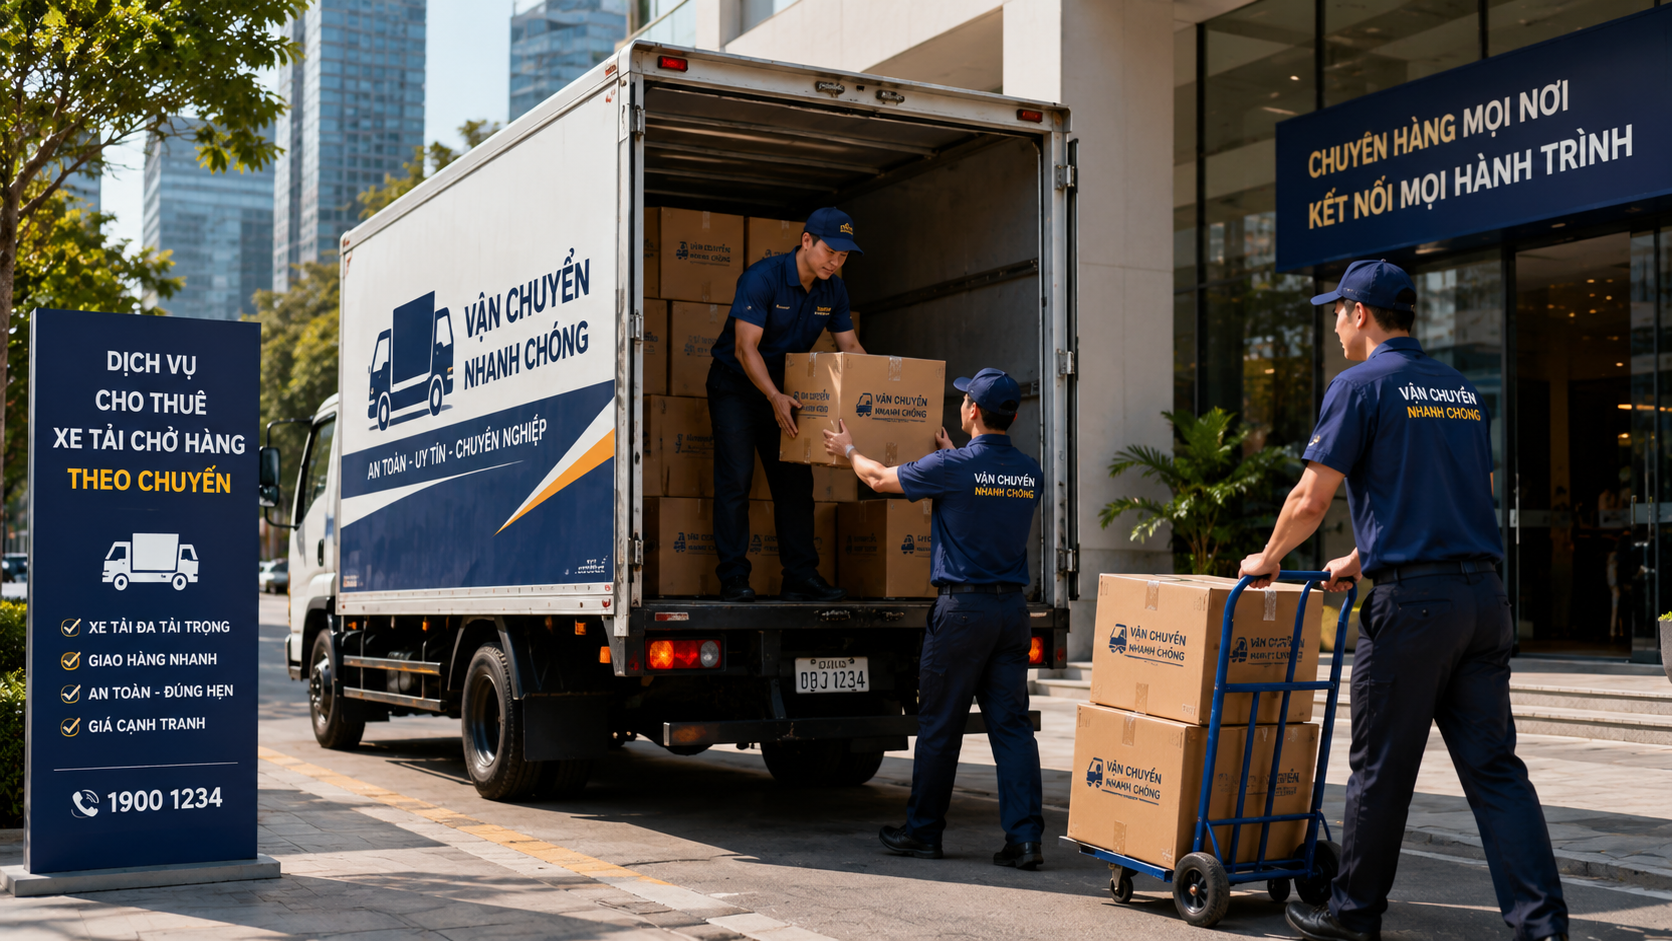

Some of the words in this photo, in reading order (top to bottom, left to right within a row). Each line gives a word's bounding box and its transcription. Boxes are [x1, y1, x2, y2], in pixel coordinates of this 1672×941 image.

[1308, 131, 1388, 179] CHUYÊN
[1394, 113, 1456, 156] HÀNG
[1463, 96, 1511, 138] MỌI
[1519, 79, 1569, 123] NƠI
[1309, 187, 1349, 230] KẾT
[1354, 175, 1393, 220] NỐI
[1400, 170, 1446, 211] MỌI
[1454, 148, 1532, 197] HÀNH
[1540, 123, 1633, 176] TRÌNH
[464, 291, 501, 343] VẬN
[506, 247, 590, 324] CHUYỂN
[107, 350, 160, 377] DỊCH
[166, 354, 197, 380] VỤ
[464, 342, 520, 390] NHANH
[525, 320, 589, 370] CHÓNG
[95, 389, 144, 412] CHO
[150, 389, 207, 415] THUÊ
[1398, 382, 1428, 404] VẬN
[1406, 406, 1445, 419] NHANH
[53, 427, 82, 449] XE
[89, 423, 124, 450] TẢI
[130, 426, 179, 453] CHỞ
[185, 428, 246, 455] HÀNG
[367, 460, 380, 480] AN
[415, 448, 428, 469] UY
[430, 442, 446, 466] TÍN
[67, 468, 131, 491] THEO
[138, 465, 231, 494] CHUYẾN
[88, 621, 107, 634] XE
[135, 621, 156, 634] ĐA
[184, 620, 230, 636] TRỌNG
[88, 654, 123, 667] GIAO
[127, 650, 166, 666] HÀNG
[169, 653, 217, 666] NHANH
[88, 687, 108, 700] AN
[112, 683, 151, 699] TOÀN
[163, 682, 203, 699] ĐÚNG
[206, 684, 234, 700] HẸN
[832, 670, 866, 689] 1234
[88, 716, 113, 733] GIÁ
[116, 718, 156, 735] CẠNH
[160, 717, 206, 730] TRANH
[107, 789, 163, 813] 1900
[170, 787, 223, 810] 1234
